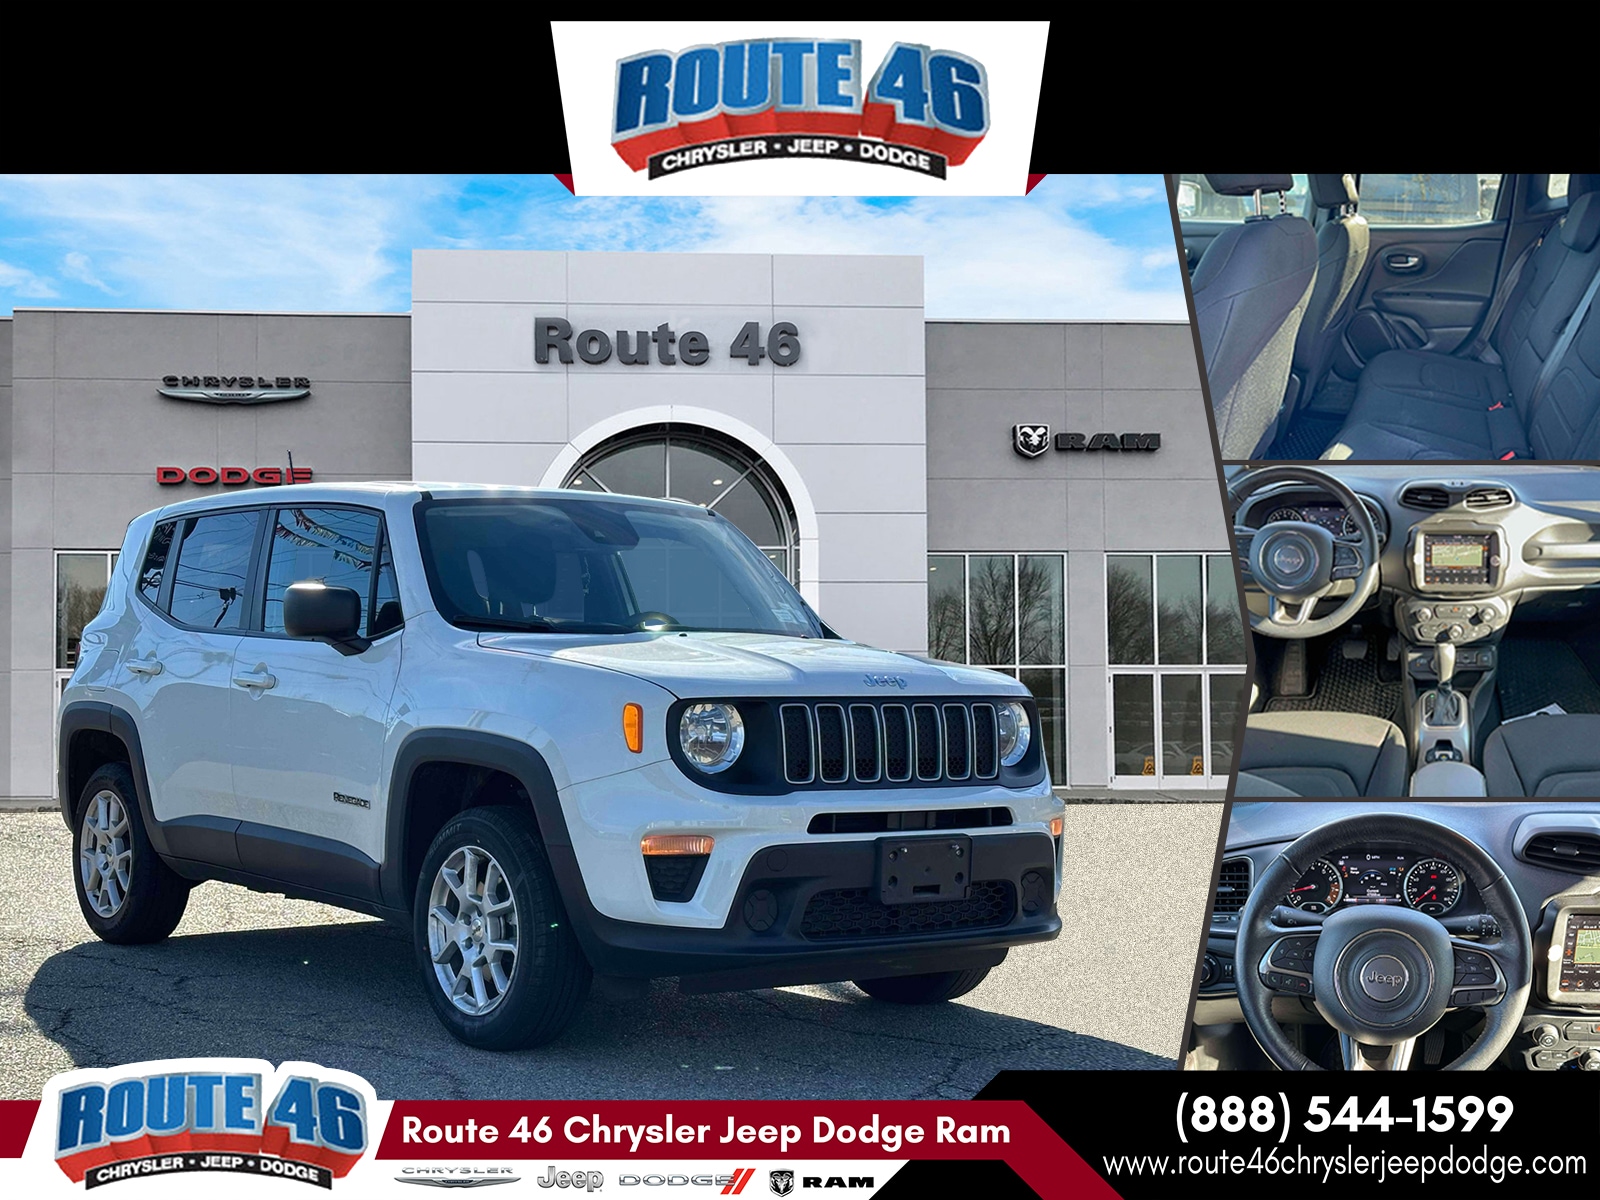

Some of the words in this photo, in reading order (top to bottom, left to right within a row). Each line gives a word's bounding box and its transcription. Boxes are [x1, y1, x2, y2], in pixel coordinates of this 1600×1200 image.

[534, 317, 711, 367] Route
[729, 321, 802, 368] 46
[162, 375, 311, 388] CHRYSLER
[1055, 432, 1161, 451] RAM
[156, 467, 313, 484] DODGE
[1366, 970, 1403, 987] Jeep
